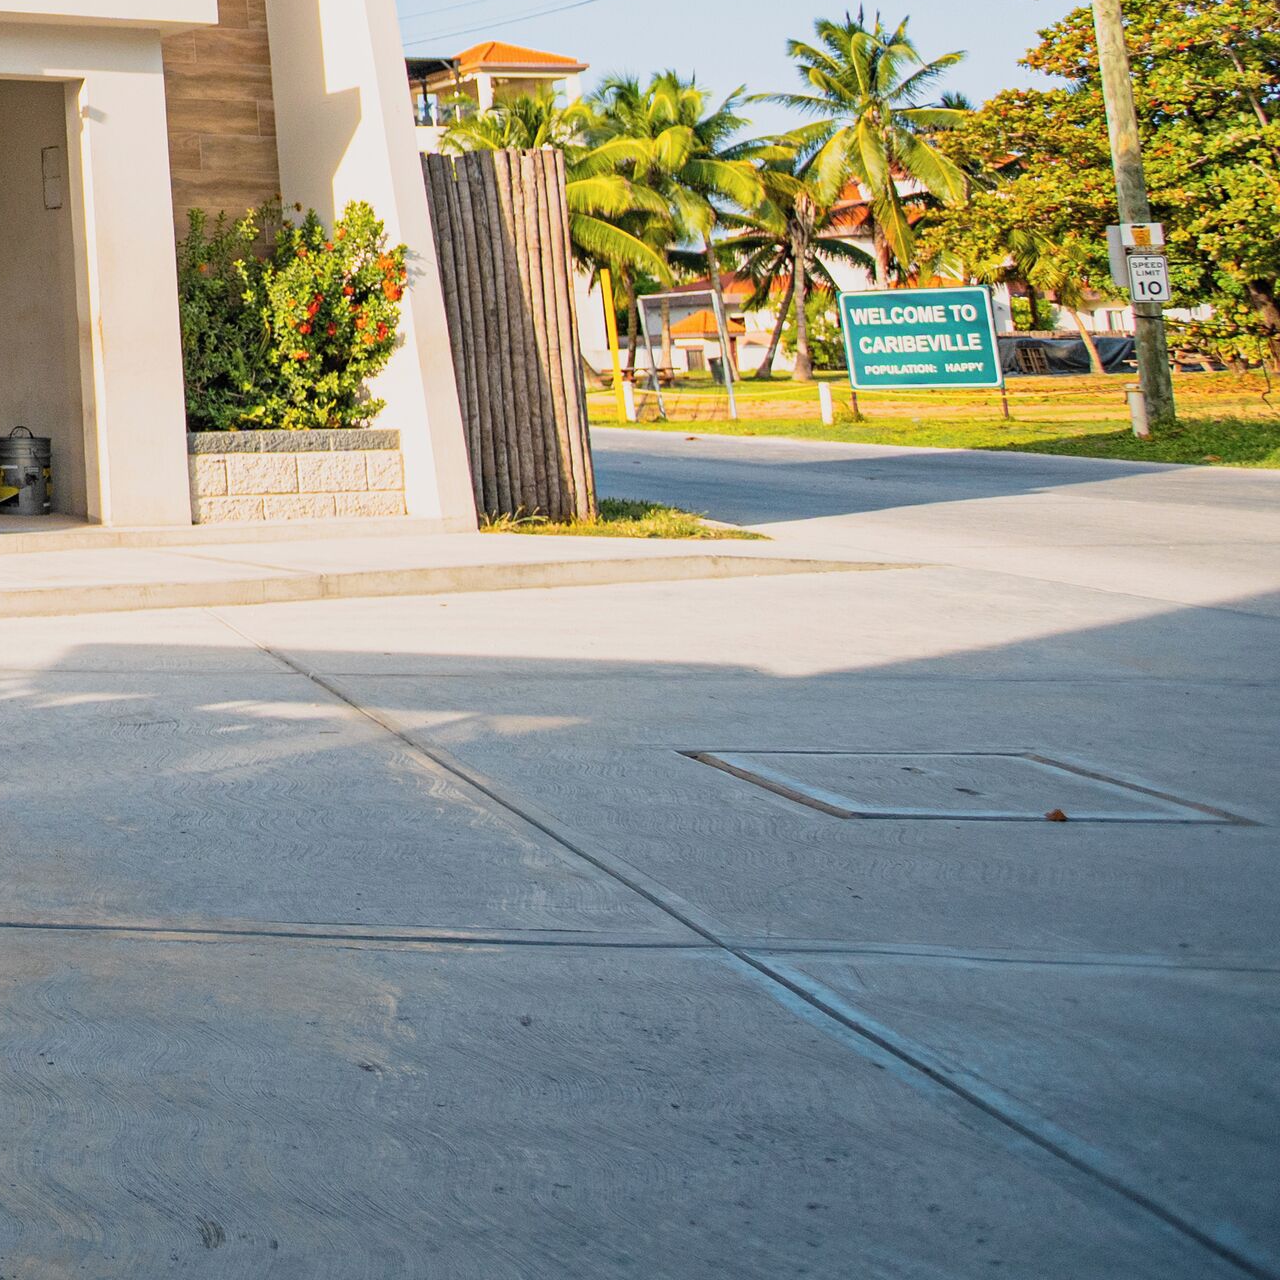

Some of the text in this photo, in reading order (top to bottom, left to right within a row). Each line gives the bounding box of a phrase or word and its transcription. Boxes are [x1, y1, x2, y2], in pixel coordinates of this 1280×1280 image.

[1135, 269, 1161, 277] LIMIT
[1138, 281, 1162, 295] 10
[849, 304, 978, 325] WELCOME TO
[859, 333, 983, 354] CARIBEVILLE
[864, 362, 984, 375] POPULATION: HAPPY
